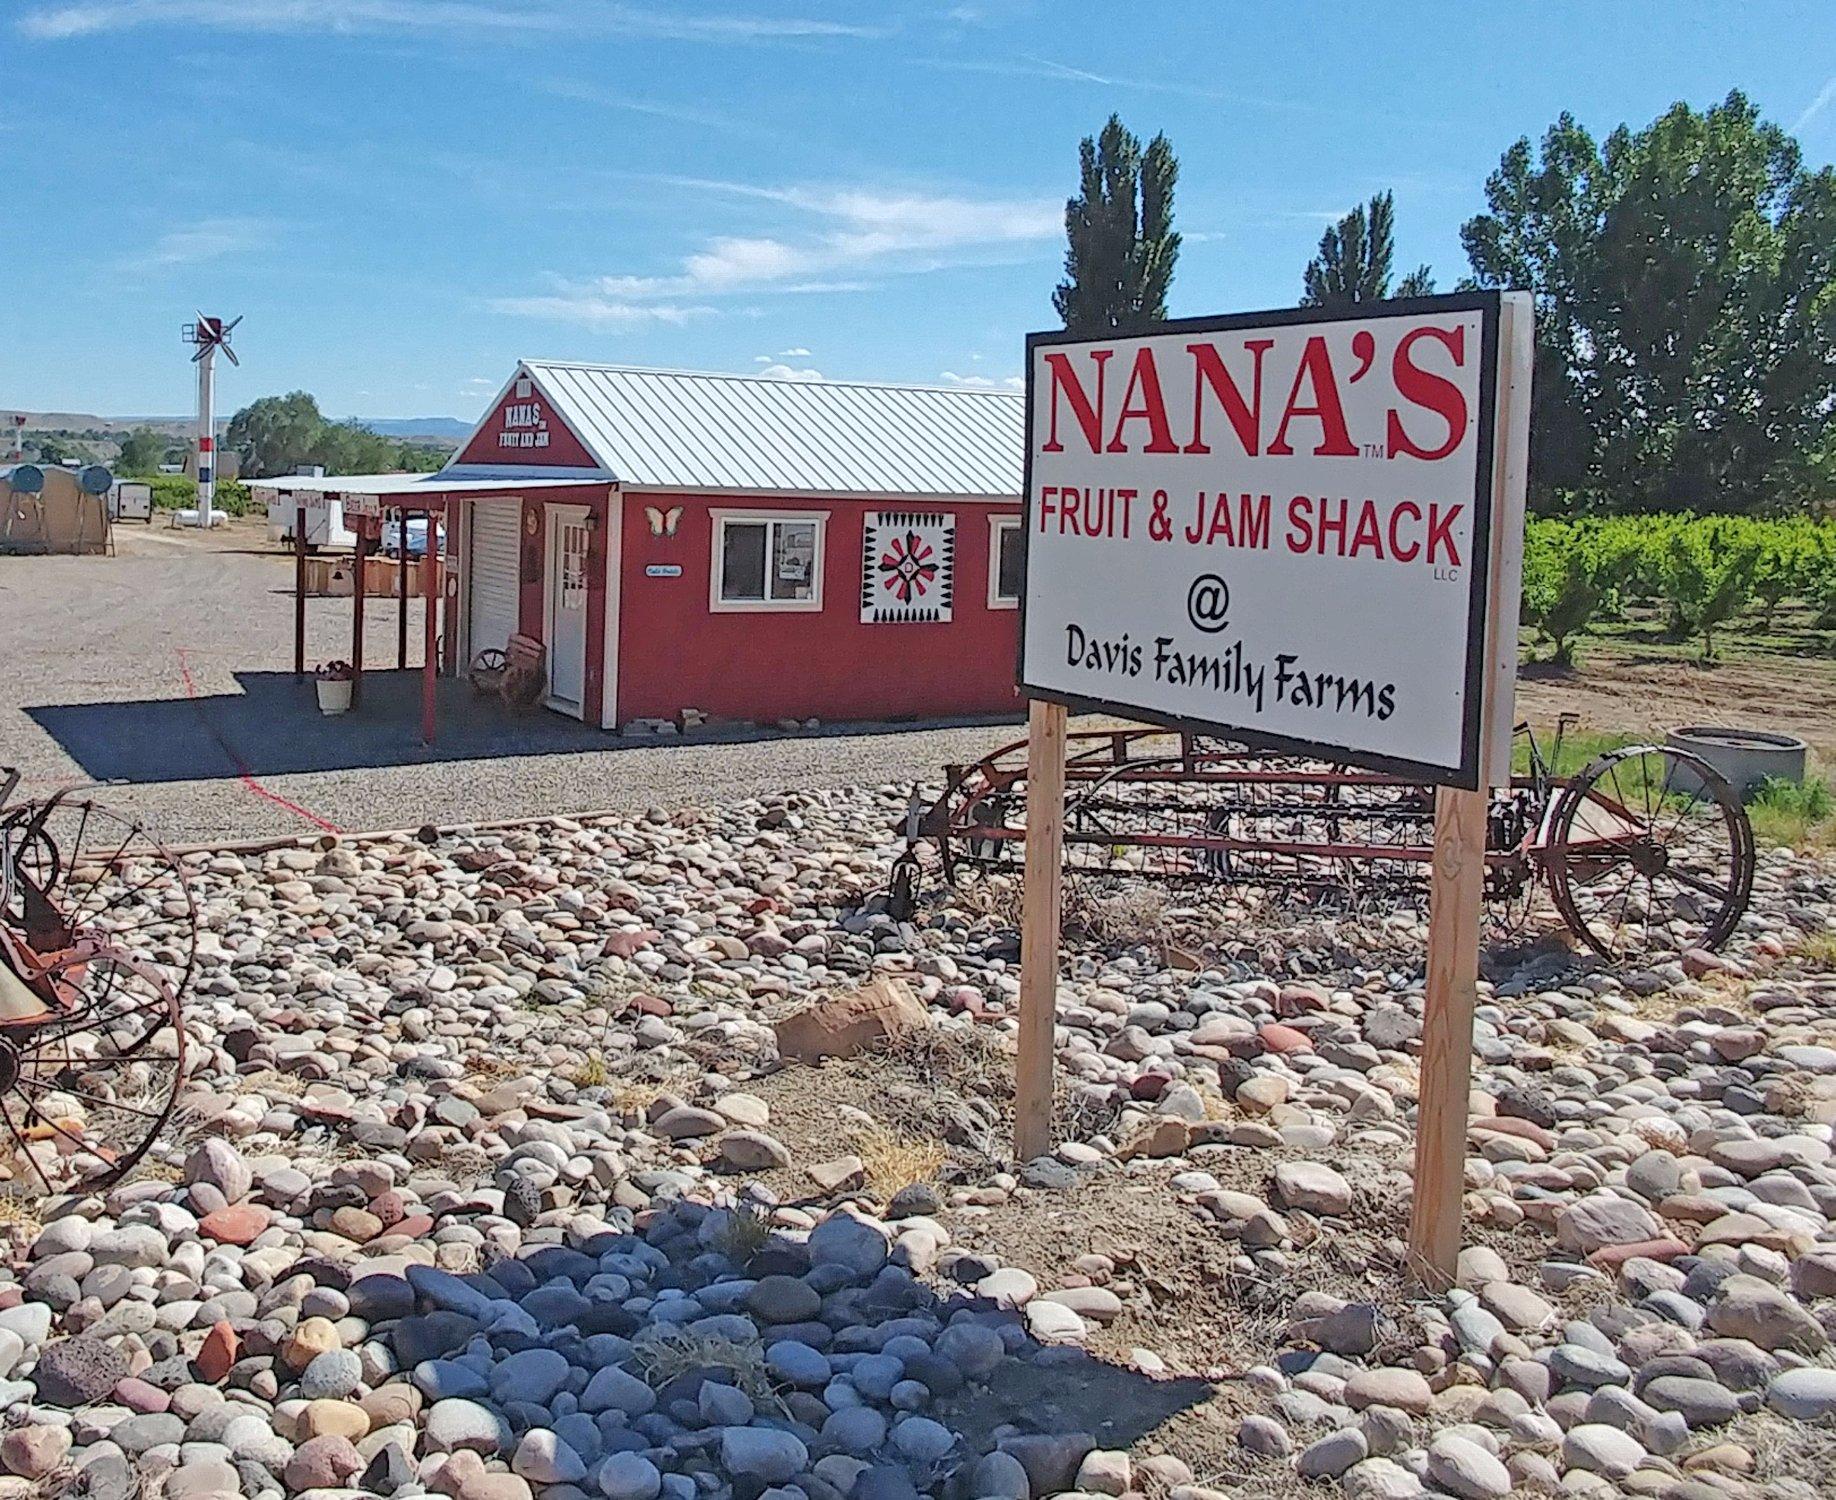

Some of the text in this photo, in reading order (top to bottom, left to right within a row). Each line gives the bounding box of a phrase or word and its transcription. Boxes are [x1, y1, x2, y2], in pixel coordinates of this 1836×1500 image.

[1042, 325, 1468, 460] NANA'S
[1363, 444, 1384, 459] TM
[1040, 487, 1464, 567] FRUIT & JAM SHACK
[1187, 573, 1230, 633] @
[1433, 568, 1458, 582] LLC
[1065, 623, 1396, 721] Davis Family Farms
